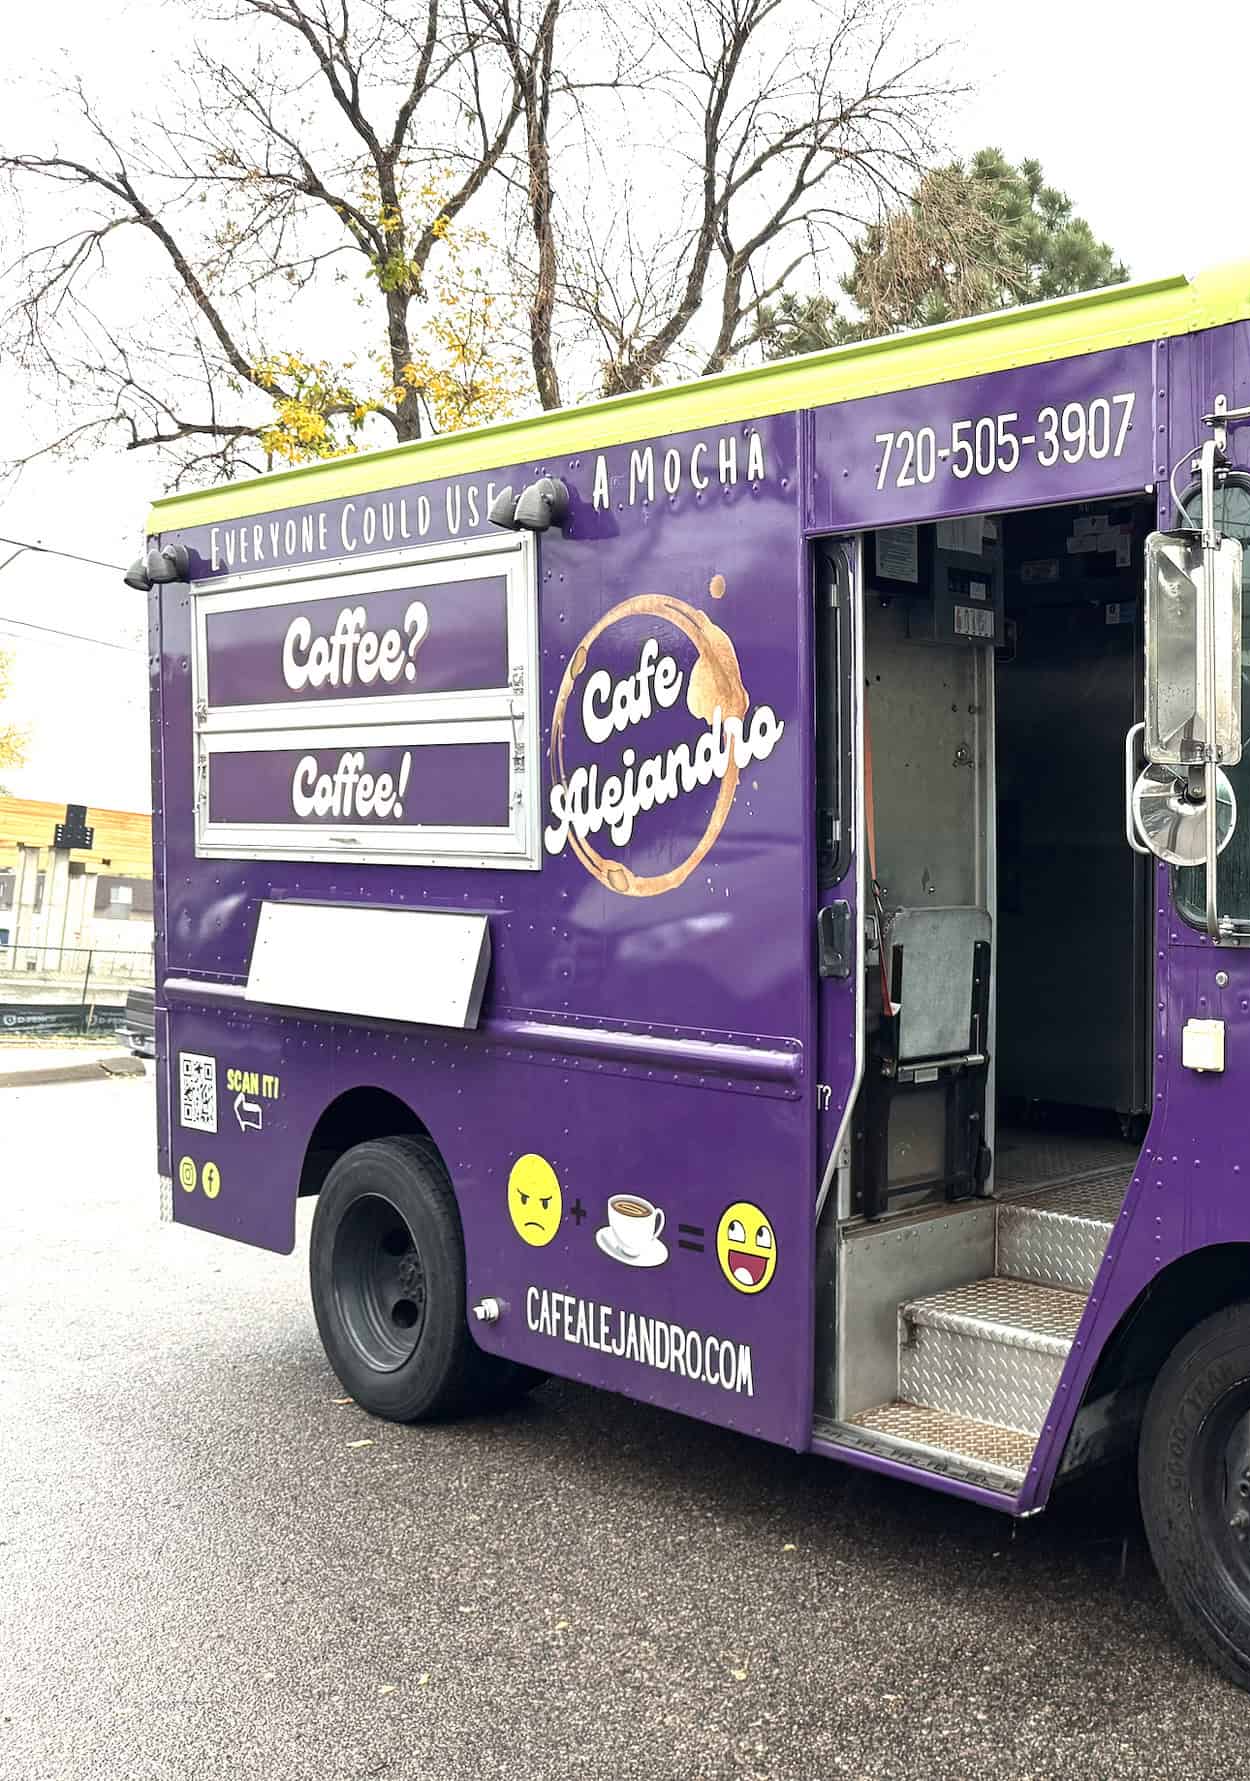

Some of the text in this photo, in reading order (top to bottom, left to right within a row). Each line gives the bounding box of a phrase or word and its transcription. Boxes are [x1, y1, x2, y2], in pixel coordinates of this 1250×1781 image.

[874, 393, 1136, 490] 720-505-3907
[210, 512, 328, 572] EVERYONE
[341, 495, 432, 552] COULD
[593, 455, 610, 512] A
[629, 431, 765, 506] MOCHA
[282, 601, 429, 690] Coffee?
[582, 638, 684, 743] Cafe
[291, 751, 412, 819] Coffee!
[543, 704, 786, 855] Alejandro
[226, 1068, 279, 1099] SCAN IT!
[525, 1285, 754, 1397] CAFEALEJANDRO.COM
